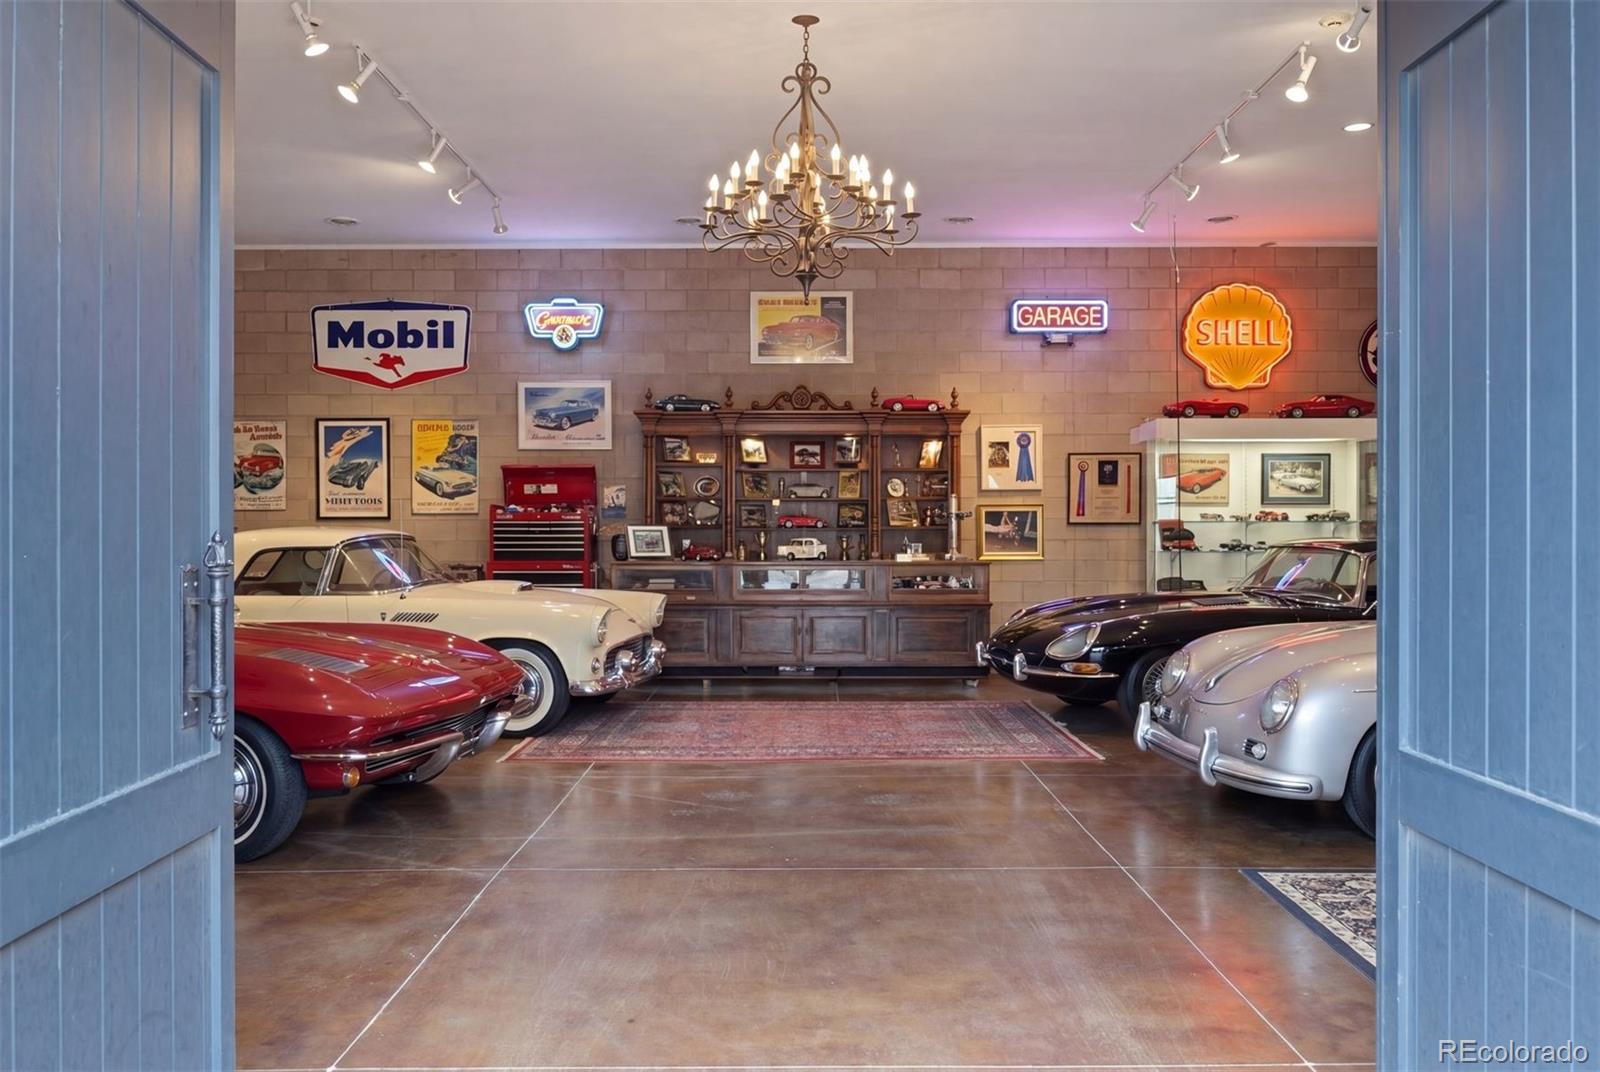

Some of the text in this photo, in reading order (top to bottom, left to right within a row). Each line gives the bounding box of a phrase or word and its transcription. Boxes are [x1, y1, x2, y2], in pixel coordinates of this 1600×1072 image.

[1018, 306, 1102, 326] GARAGE
[327, 319, 455, 349] Mobil
[1196, 319, 1282, 346] SHELL
